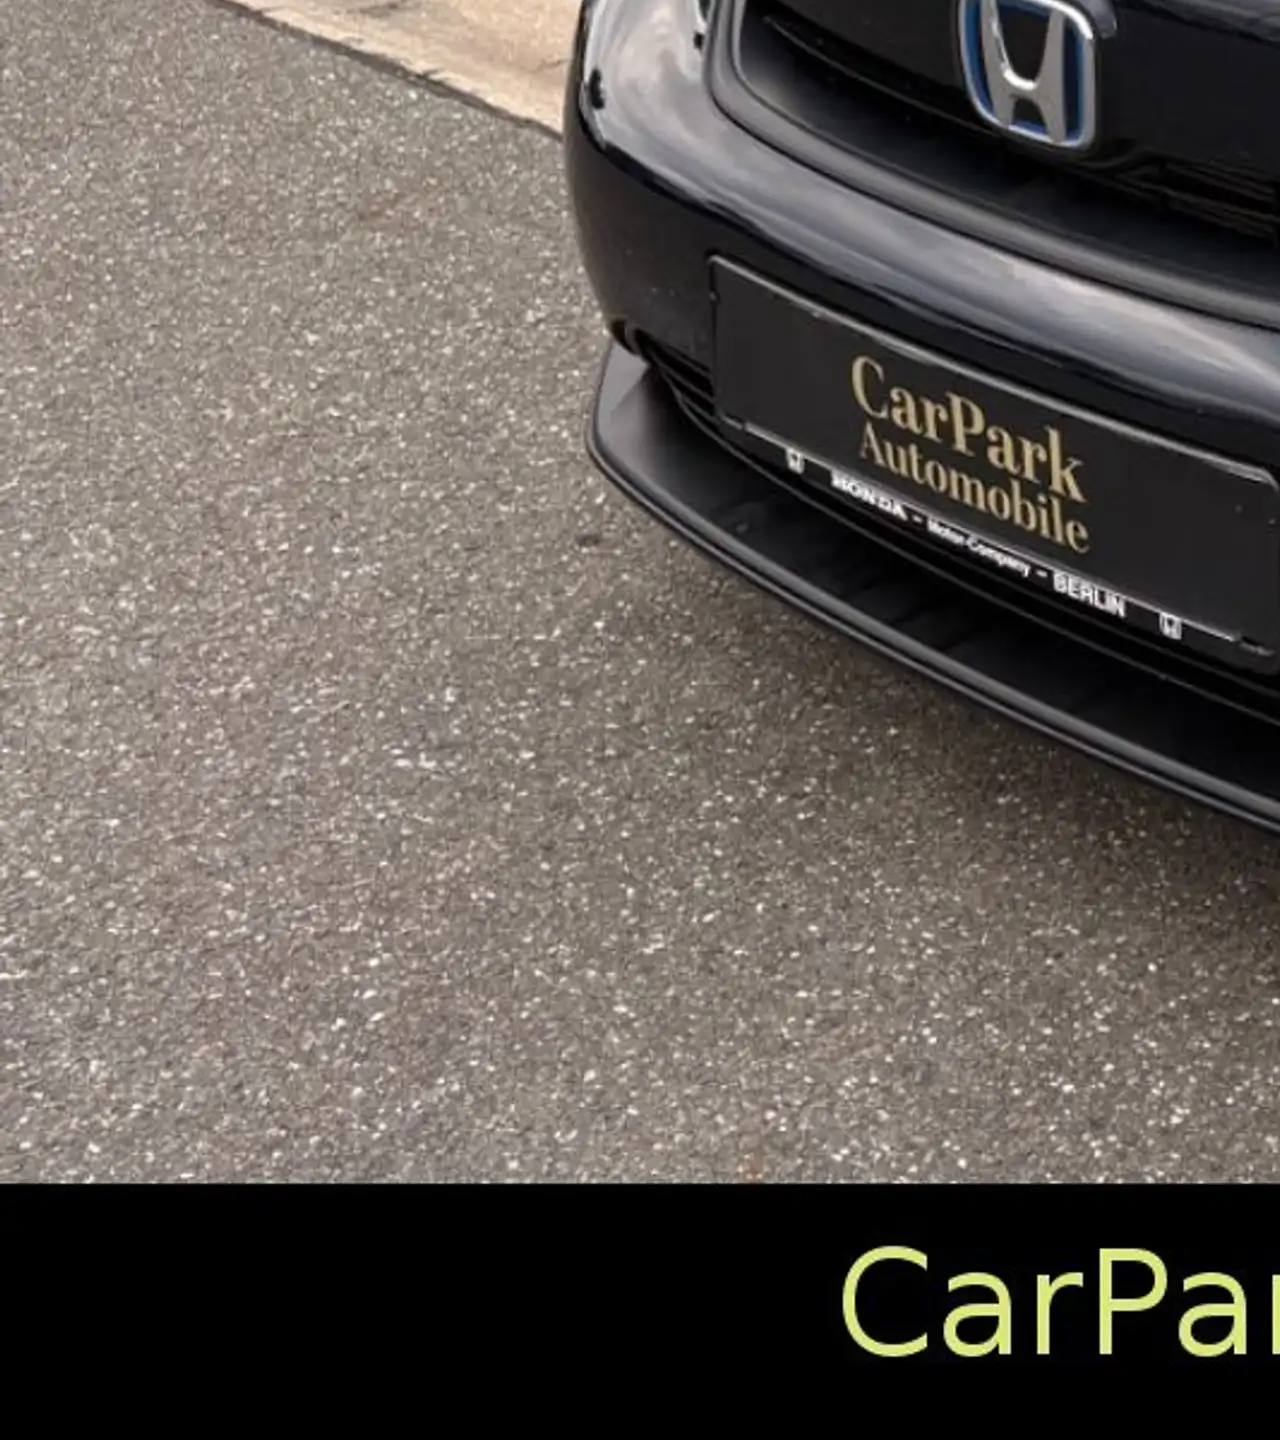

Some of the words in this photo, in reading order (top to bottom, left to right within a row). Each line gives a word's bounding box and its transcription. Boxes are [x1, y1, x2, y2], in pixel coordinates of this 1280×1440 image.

[851, 355, 1087, 504] CarPark
[859, 420, 1090, 554] Automobile
[831, 471, 908, 521] HONDA
[1053, 571, 1126, 619] BERLIN
